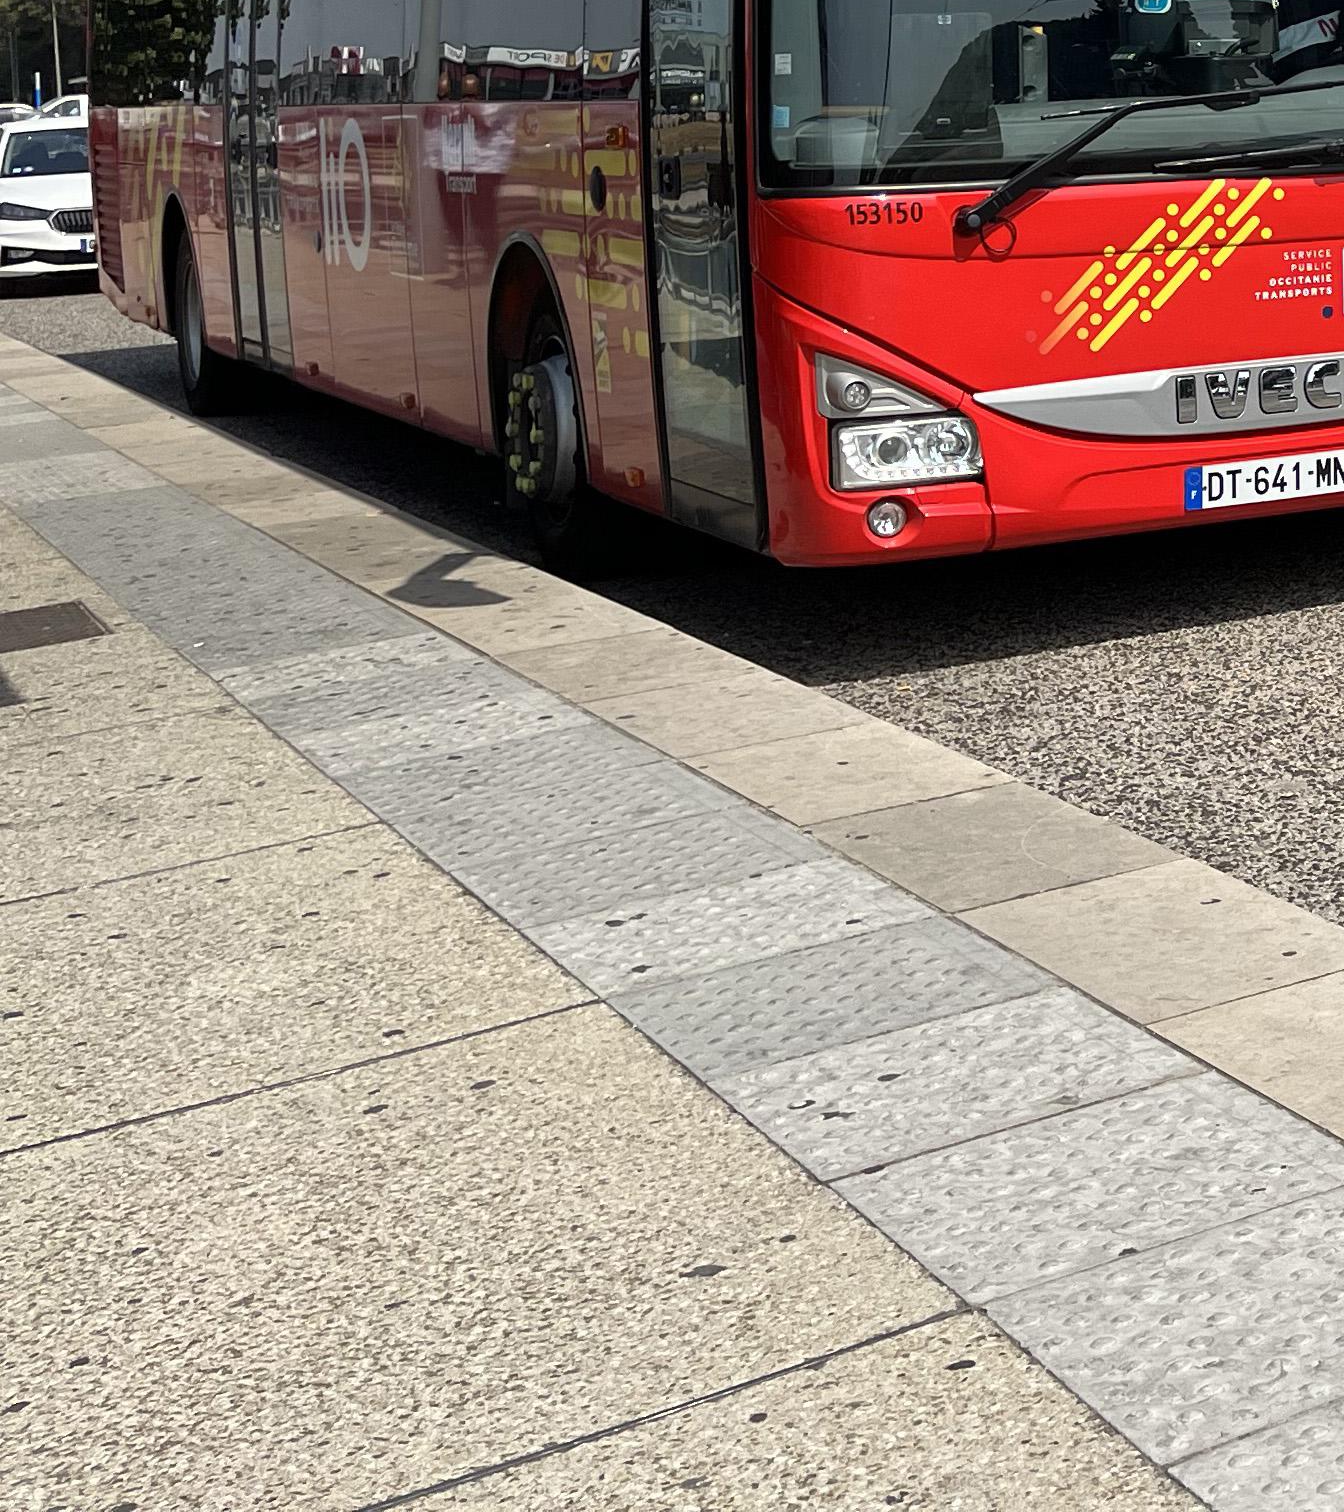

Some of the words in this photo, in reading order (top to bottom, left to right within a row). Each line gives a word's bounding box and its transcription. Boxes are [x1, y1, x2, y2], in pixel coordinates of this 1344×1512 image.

[845, 202, 923, 225] 153150
[1283, 249, 1332, 261] SERVICE
[1290, 262, 1332, 273] PUBLIC
[1269, 274, 1333, 287] OCCITANIE
[1255, 287, 1333, 301] TRANSPORTS
